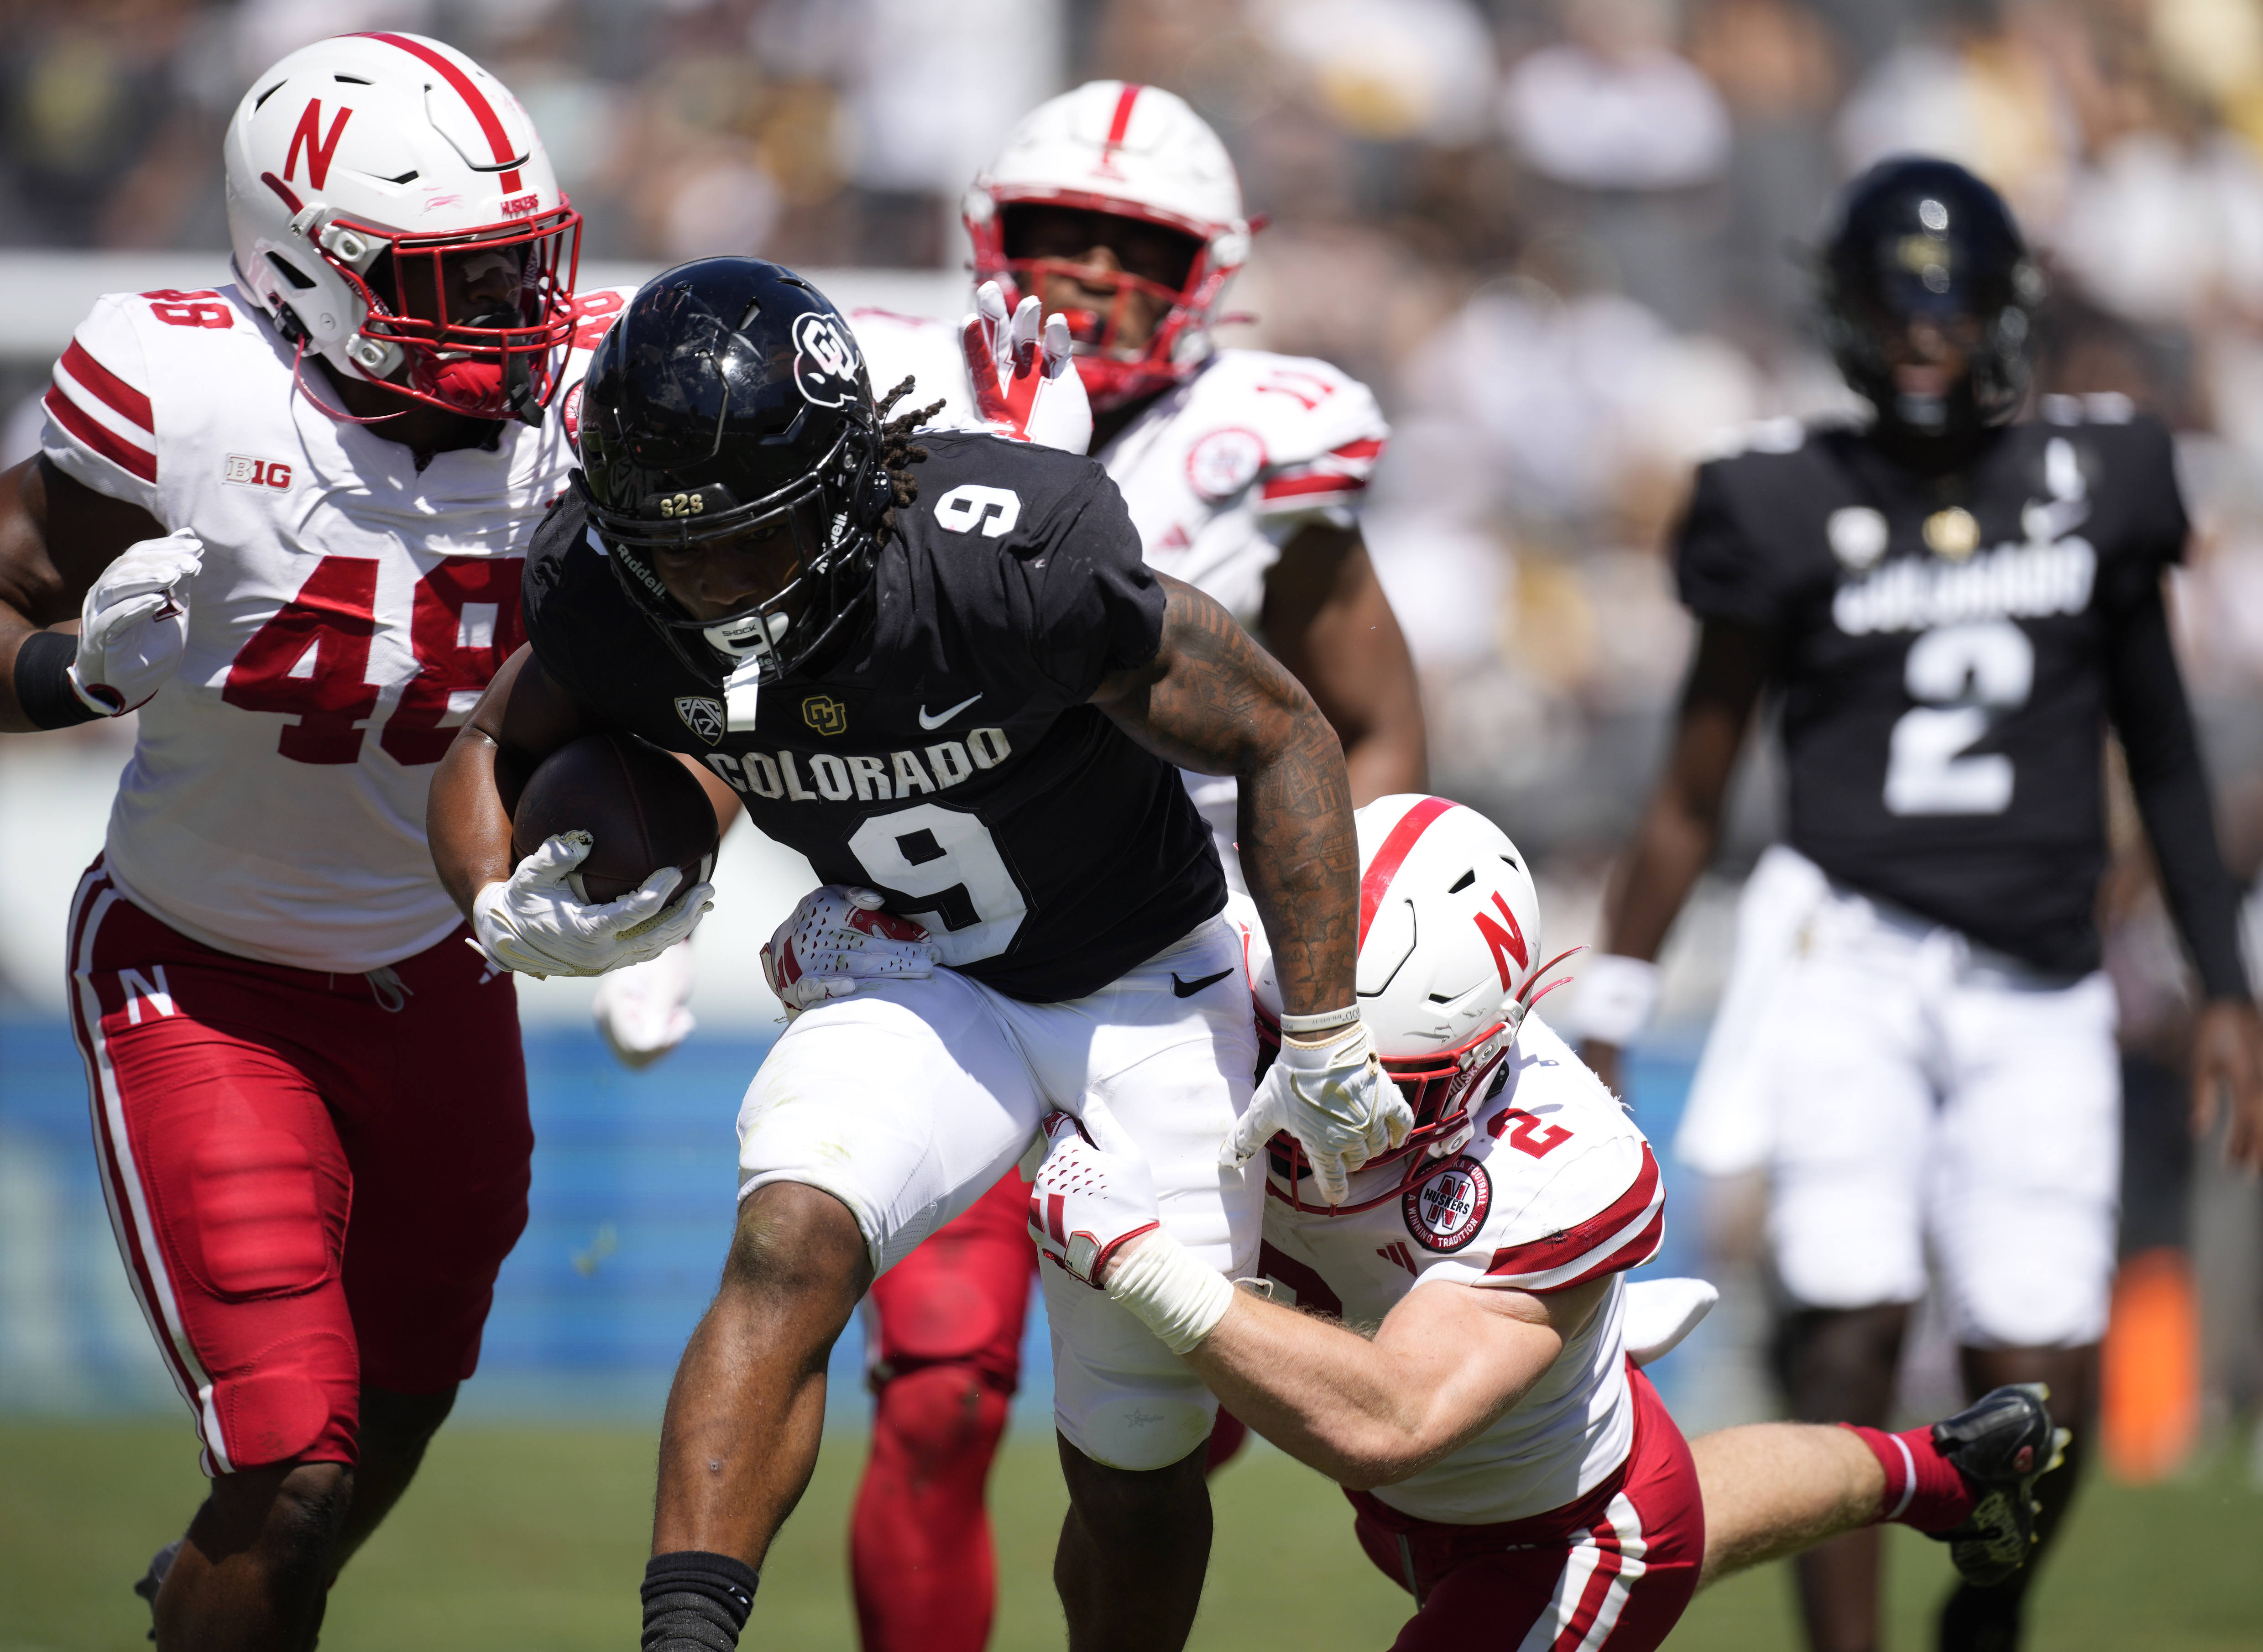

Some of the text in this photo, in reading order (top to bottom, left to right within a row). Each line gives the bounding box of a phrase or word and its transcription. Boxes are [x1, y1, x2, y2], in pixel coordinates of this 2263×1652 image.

[284, 98, 353, 191] N
[501, 193, 538, 215] HUSKERS
[802, 319, 855, 381] CU
[660, 493, 703, 518] S2S
[933, 485, 1021, 538] 9
[617, 543, 666, 597] Riddell
[722, 624, 757, 636] SHOCK
[221, 555, 530, 766] 48
[677, 699, 721, 728] PAC
[693, 718, 718, 736] 12
[802, 695, 846, 736] CU
[1882, 615, 2035, 816] 2
[705, 728, 1012, 801] COLORADO
[847, 803, 1029, 967] 9
[1473, 890, 1529, 995] N
[118, 965, 175, 1025] N
[1487, 1108, 1574, 1159] 2
[1423, 1188, 1469, 1215] HUSKERS
[1468, 1164, 1487, 1206] FOOTBALL
[1408, 1207, 1433, 1244] WINNING
[1438, 1218, 1478, 1247] TRADITION
[1066, 1260, 1073, 1268] 2
